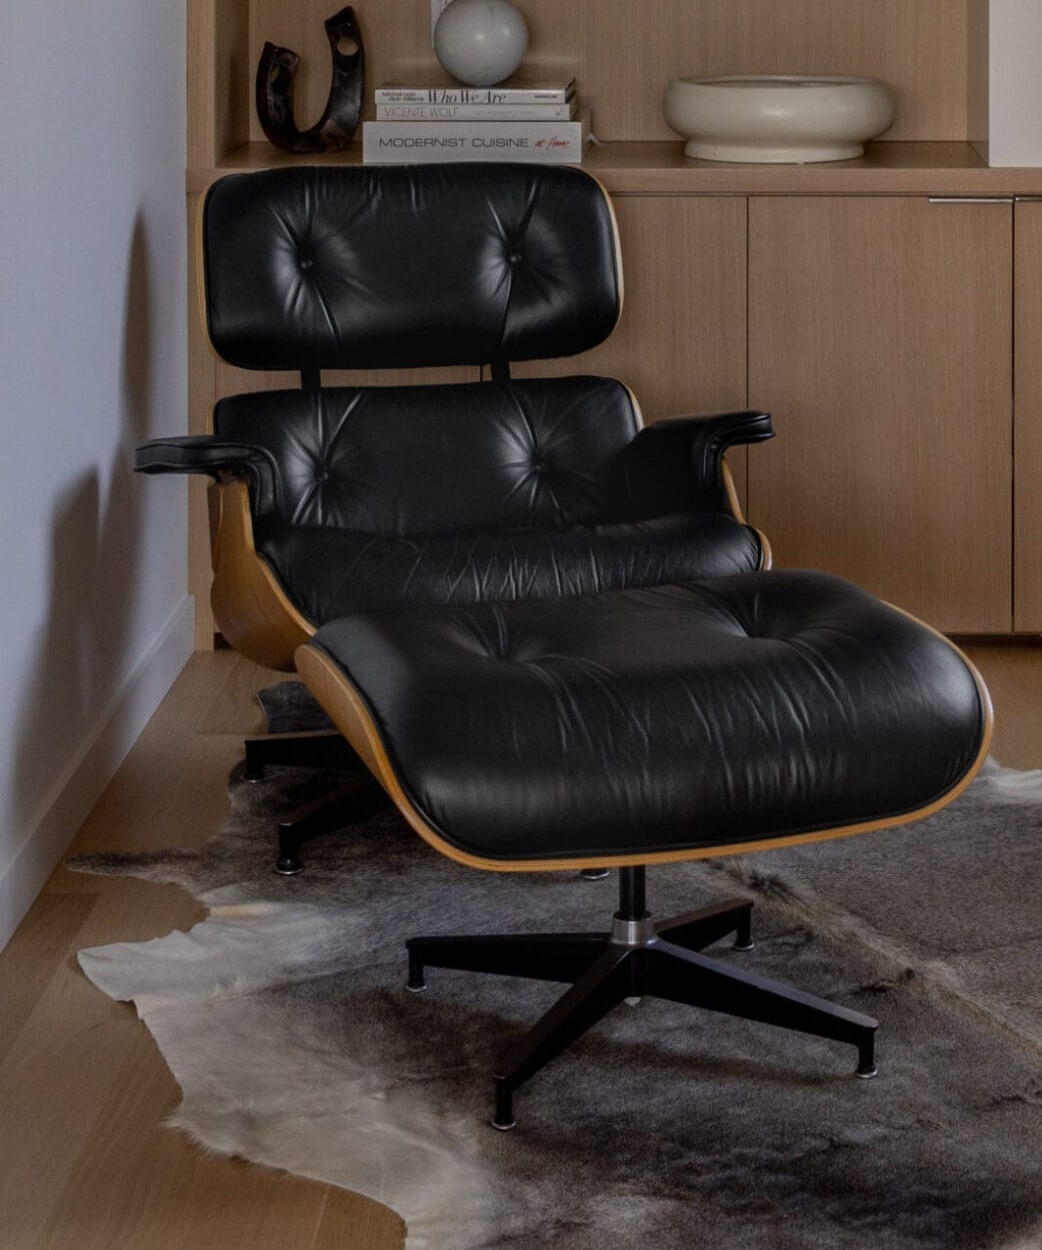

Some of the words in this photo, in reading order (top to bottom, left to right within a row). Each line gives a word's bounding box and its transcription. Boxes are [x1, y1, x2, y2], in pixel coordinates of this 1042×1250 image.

[427, 90, 458, 104] Who
[460, 90, 480, 104] We
[481, 90, 507, 104] Are
[384, 106, 427, 118] VICENTE
[378, 137, 467, 148] MODERNIST
[471, 137, 529, 148] CUISINE
